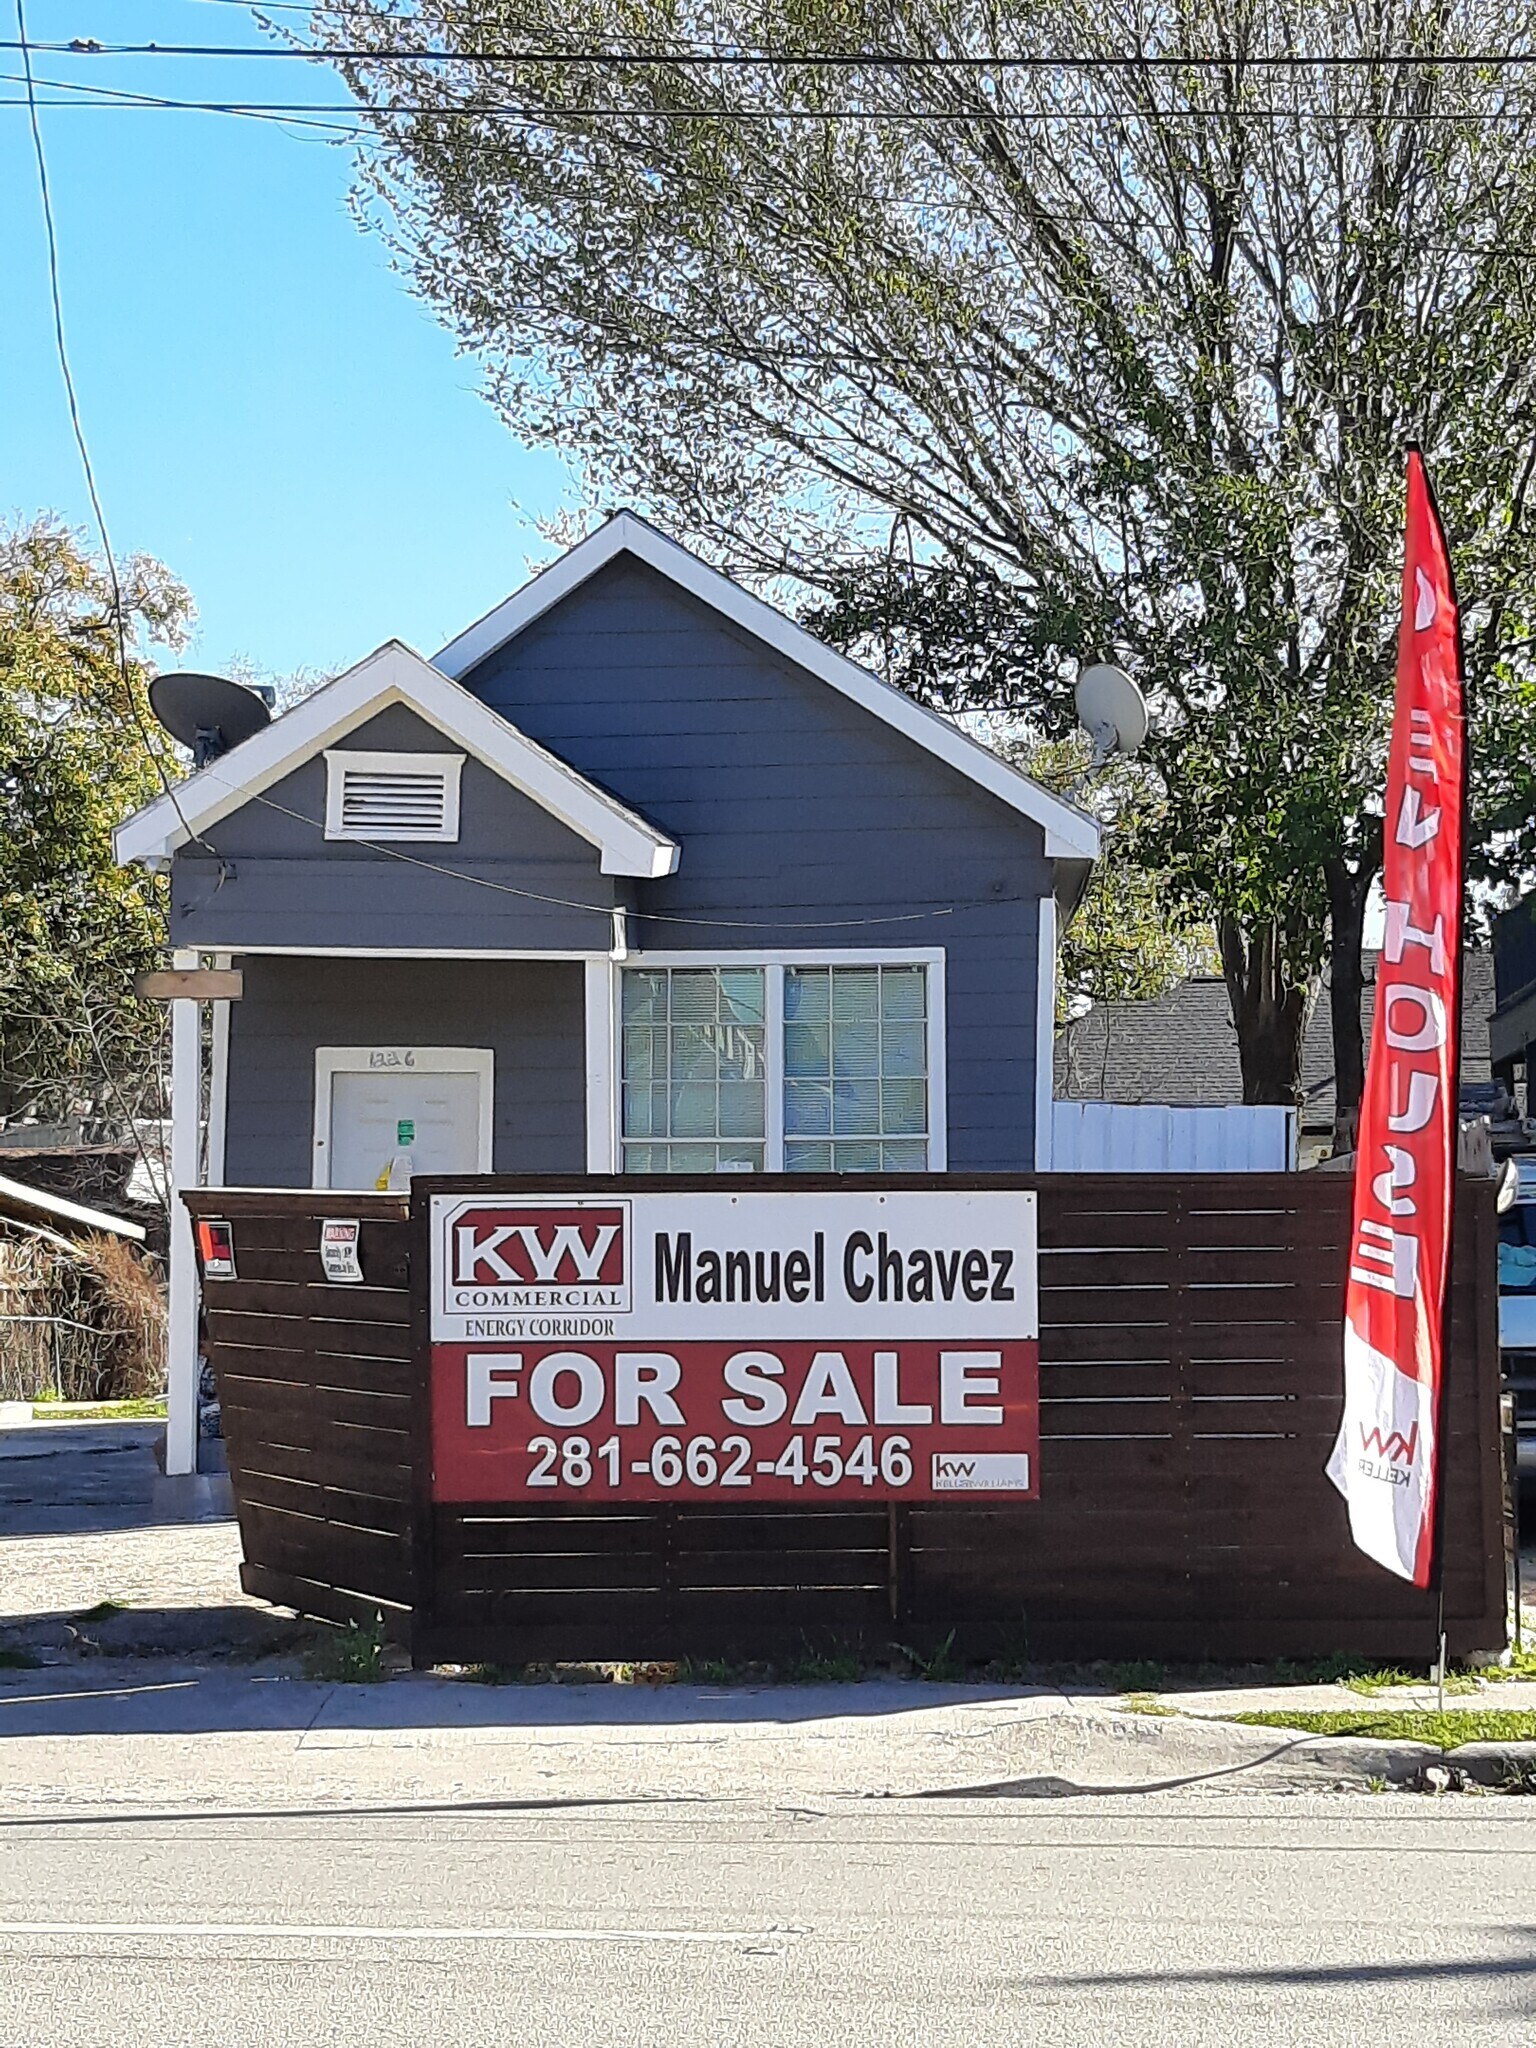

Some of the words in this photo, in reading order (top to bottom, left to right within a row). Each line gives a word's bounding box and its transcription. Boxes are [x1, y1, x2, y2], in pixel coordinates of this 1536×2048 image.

[455, 1224, 621, 1282] KW
[655, 1232, 825, 1303] Manuel
[844, 1230, 1015, 1302] Chavez
[455, 1291, 622, 1307] COMMERCIAL
[465, 1319, 526, 1337] ENERGY
[529, 1318, 614, 1336] CORRIDOR
[466, 1351, 686, 1427] FOR
[721, 1350, 1005, 1427] SALE
[526, 1435, 913, 1488] 281-662-4546
